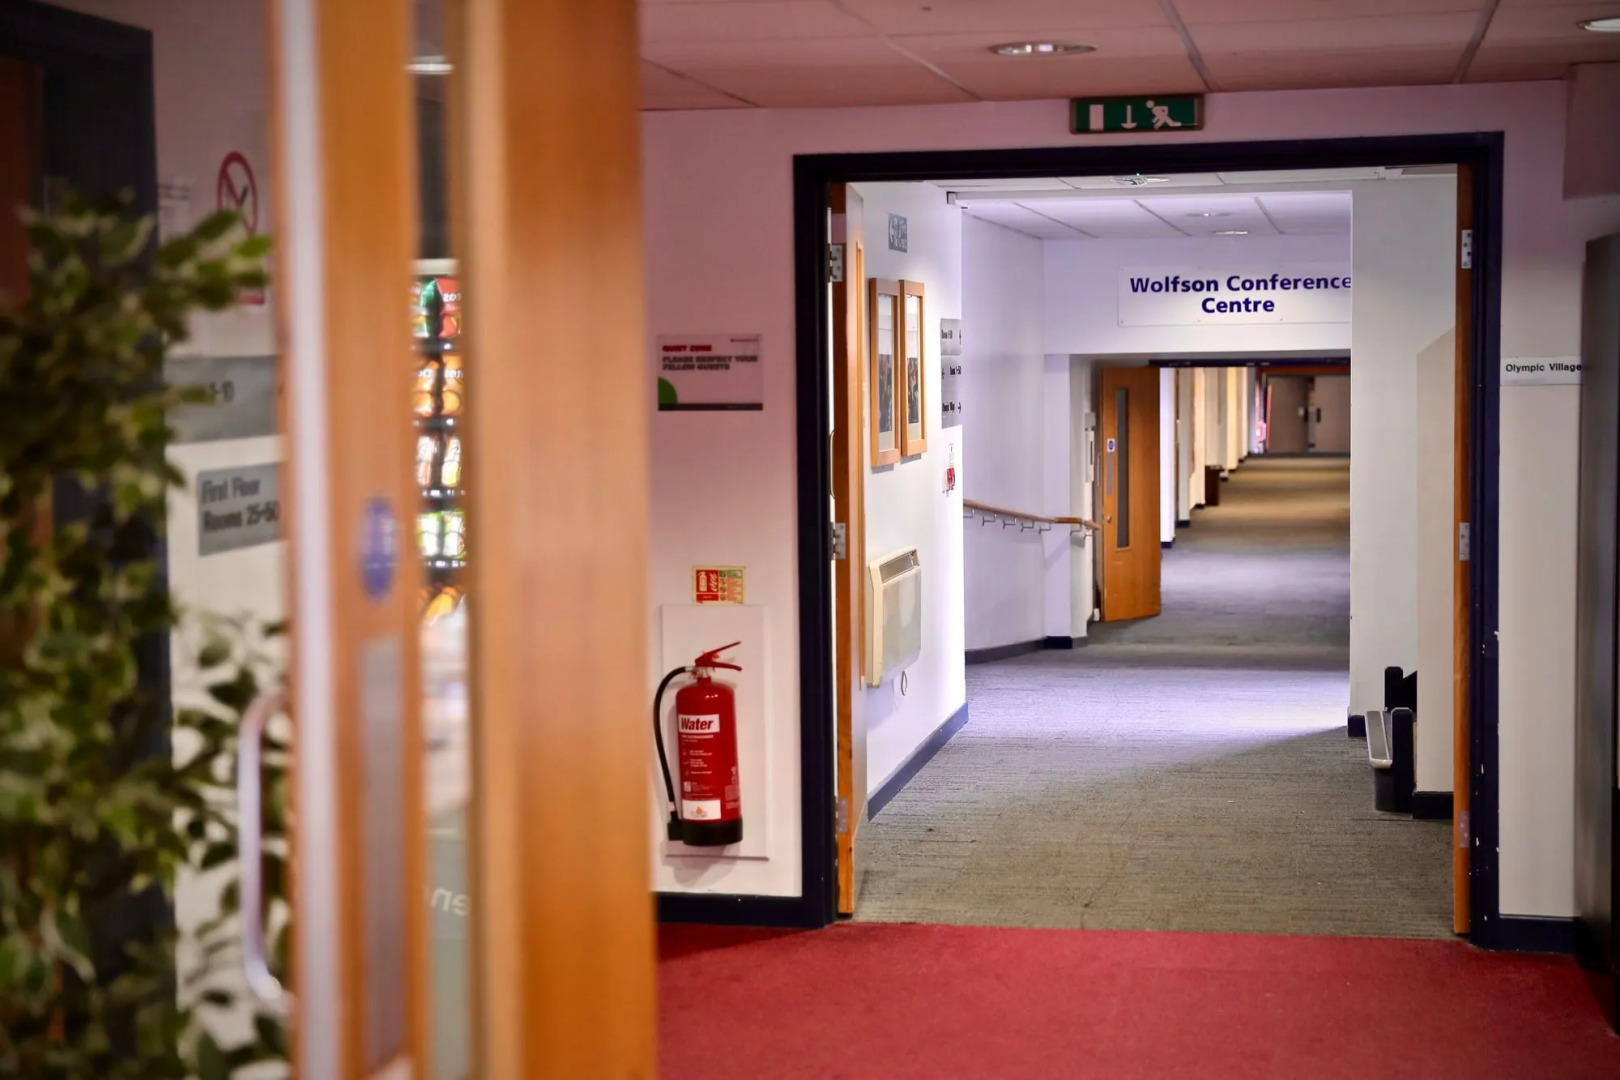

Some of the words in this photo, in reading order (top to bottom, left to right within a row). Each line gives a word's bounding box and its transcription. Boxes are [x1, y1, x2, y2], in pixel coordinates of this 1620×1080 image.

[1130, 276, 1219, 293] Wolfson
[1226, 274, 1351, 291] Conference
[1201, 297, 1275, 313] Centre
[1505, 363, 1545, 373] Olympic
[1549, 363, 1583, 373] Village
[681, 717, 714, 730] Water
